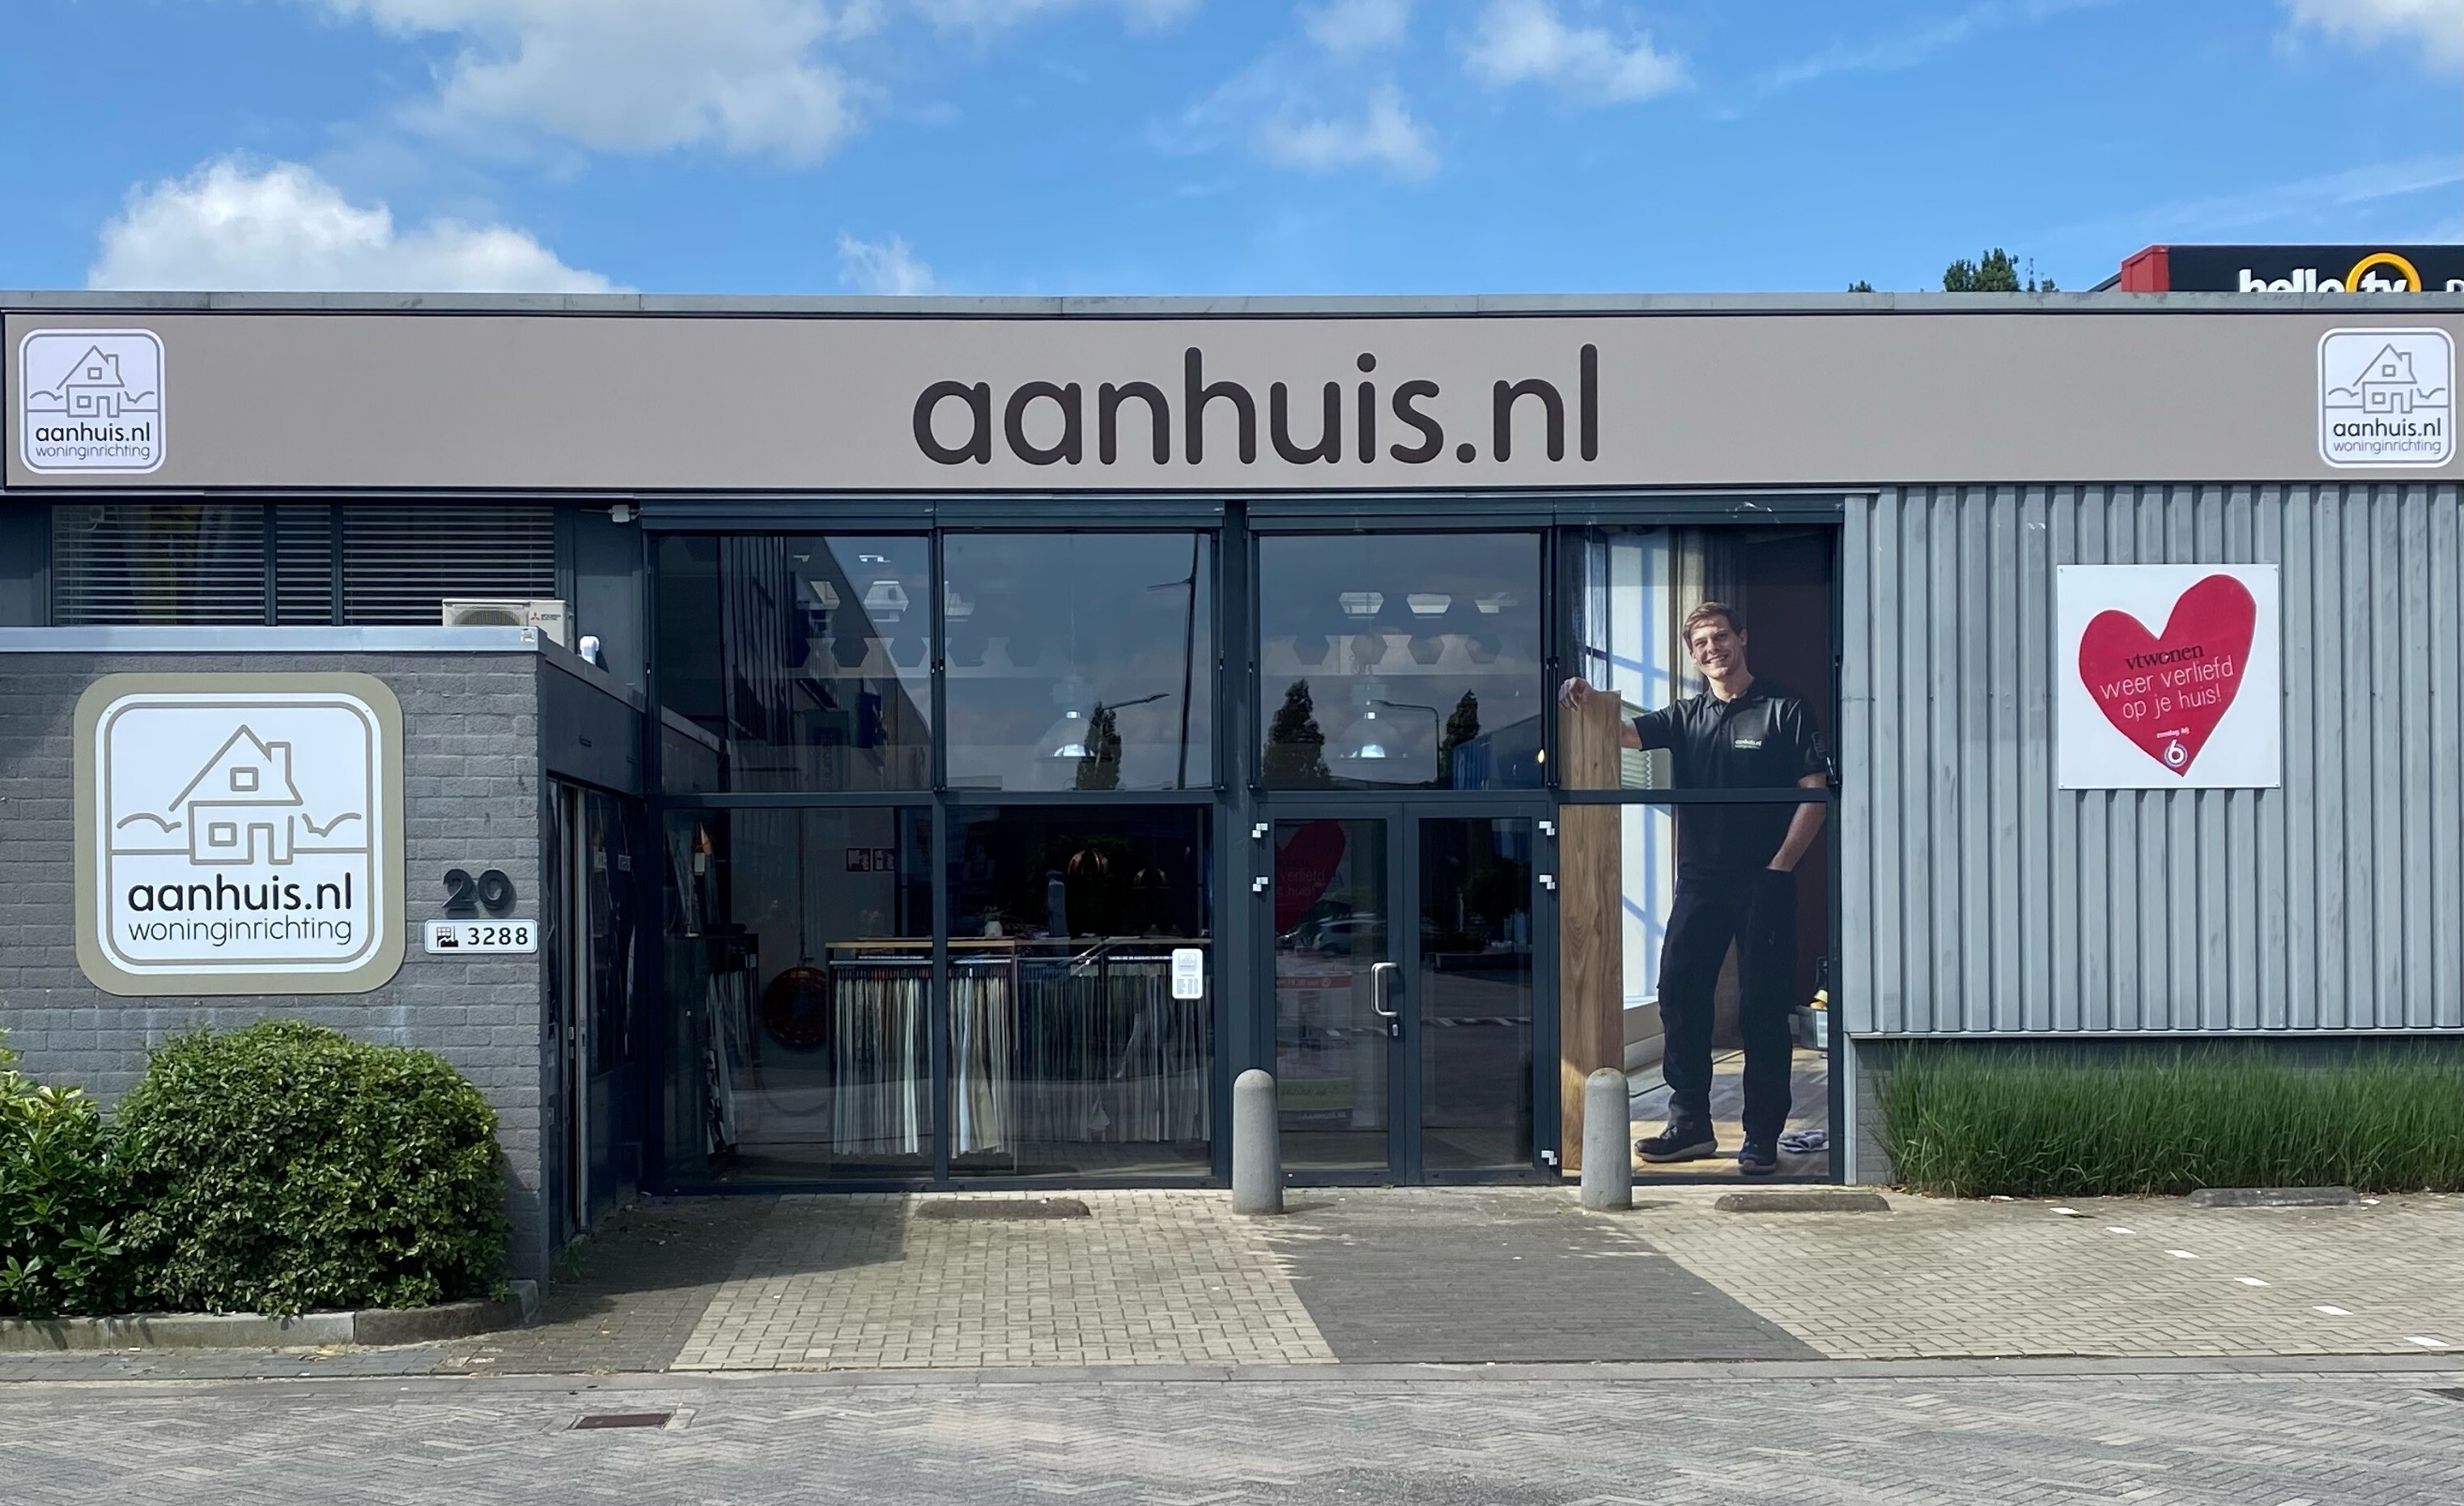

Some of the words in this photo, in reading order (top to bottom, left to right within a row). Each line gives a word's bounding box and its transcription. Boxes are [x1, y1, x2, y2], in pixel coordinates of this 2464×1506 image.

[912, 344, 1598, 466] aanhuis.nl
[36, 422, 150, 442] aanhuis.nl
[2333, 418, 2441, 437] aanhuis.nl
[36, 444, 150, 460] woninginrichting
[2333, 440, 2441, 455] woninginrichting
[2125, 645, 2204, 670] vtwonen
[2100, 675, 2154, 699] weer
[2160, 655, 2233, 688] verliefd
[2122, 698, 2148, 721] op
[2153, 694, 2173, 719] je
[2178, 683, 2222, 710] huis!
[128, 872, 351, 912] aanhuis.nl
[443, 869, 511, 910] 20
[128, 914, 351, 947] woninginrichting
[467, 927, 528, 945] 3288
